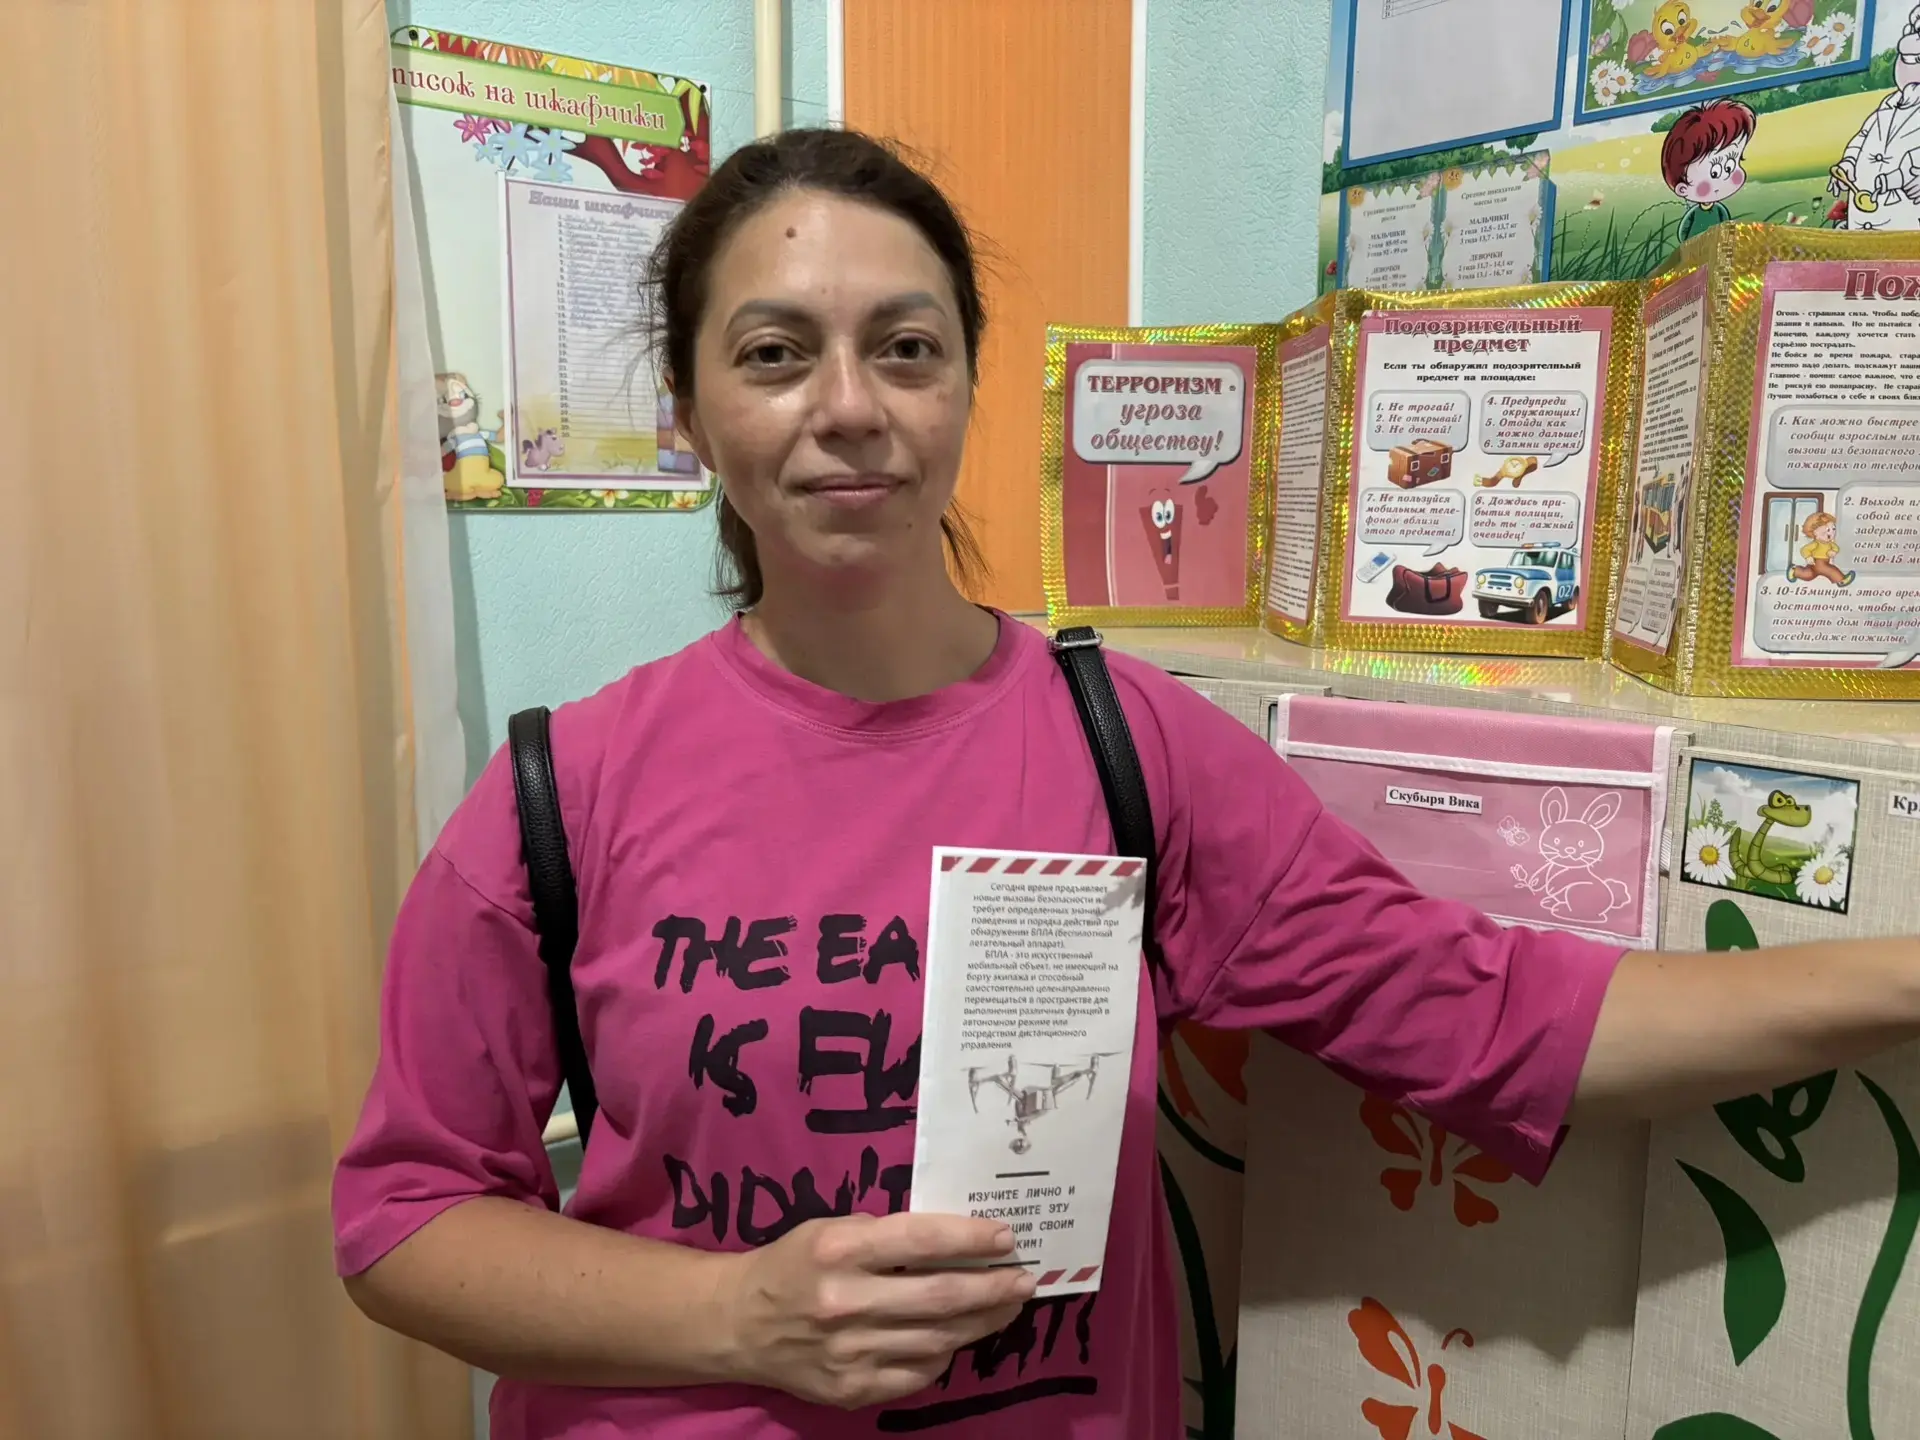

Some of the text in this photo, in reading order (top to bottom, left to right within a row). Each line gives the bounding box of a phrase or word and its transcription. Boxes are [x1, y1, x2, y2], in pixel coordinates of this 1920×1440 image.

[391, 65, 667, 131] писок на шкафчики
[1469, 214, 1510, 225] МАЛЬЧИКИ
[1384, 316, 1583, 338] Подозрительный
[1433, 337, 1531, 356] предмет
[1383, 362, 1407, 370] Если
[1430, 361, 1488, 372] обнаружил
[1417, 374, 1459, 383] предмет
[1481, 374, 1536, 383] площадке:
[1088, 375, 1223, 395] ТЕРРОРИЗМ
[1376, 402, 1455, 413] 1. Не трогай!
[1487, 396, 1566, 408] 4. Предупреди
[1120, 403, 1203, 425] угроза
[1376, 414, 1463, 424] 2. Не открывай!
[1502, 408, 1581, 419] окружающих!
[1485, 418, 1495, 427] 5.
[1499, 418, 1542, 427] Отойди
[1778, 416, 1919, 429] 1. Как можно быстрее
[1374, 424, 1452, 434] 3. Не двигай!
[1496, 429, 1584, 438] можно дальше!
[1790, 430, 1835, 442] сообщи
[1839, 433, 1897, 443] взрослым
[1090, 429, 1224, 457] обществу!
[1483, 439, 1493, 448] 6.
[1543, 440, 1581, 450] время!
[1787, 446, 1915, 456] вызови из безопасного
[1787, 461, 1849, 472] пожарных
[1367, 493, 1451, 505] 7. Не пользуйся
[1475, 497, 1566, 509] 8. Дождись при-
[1843, 496, 1904, 506] 2. Выходя
[1366, 504, 1425, 513] мобильным
[1474, 508, 1564, 520] бытия полиции,
[1365, 515, 1440, 526] фоном вблизи
[1856, 511, 1890, 520] собой
[1473, 519, 1497, 527] ведь
[1529, 521, 1574, 529] важный
[1364, 527, 1456, 537] этого предмета!
[1473, 531, 1525, 542] очевидец!
[1855, 525, 1918, 537] задержать
[1854, 541, 1881, 549] огня
[1886, 541, 1899, 549] из
[1873, 554, 1903, 564] 10-15
[1558, 585, 1572, 599] 02
[1760, 586, 1771, 596] 3.
[1856, 589, 1892, 597] этого
[1773, 601, 1853, 612] достаточно,
[1858, 603, 1896, 612] чтобы
[1772, 617, 1833, 628] покинуть
[1836, 617, 1859, 627] дом
[1389, 789, 1480, 809] Скубыря Вика
[1893, 795, 1920, 815] Кр
[652, 914, 798, 994] THE
[663, 1145, 914, 1246] DIDN'T
[968, 1185, 1076, 1203] ИЗУЧИТЕ ЛИЧНО И
[970, 1203, 1070, 1219] РАССКАЖИТЕ ЭТУ
[1039, 1219, 1075, 1231] СВОИМ
